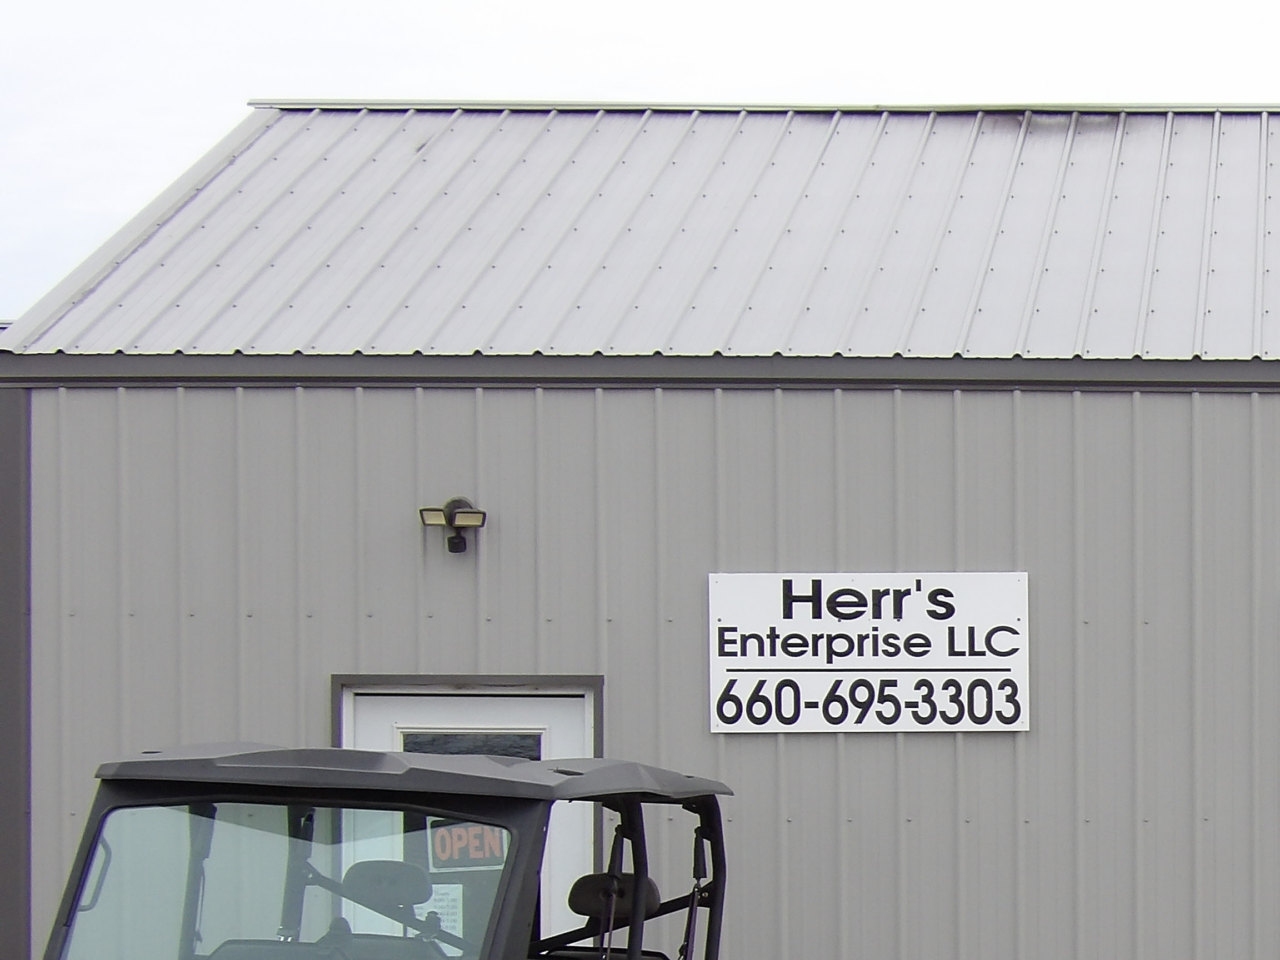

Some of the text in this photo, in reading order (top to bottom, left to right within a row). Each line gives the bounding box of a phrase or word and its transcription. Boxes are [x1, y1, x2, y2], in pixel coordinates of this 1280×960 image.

[782, 579, 956, 620] Herr's
[717, 625, 1020, 664] Enterprise LLC
[716, 678, 1021, 725] 660-695-3303
[435, 826, 502, 861] OPEN
